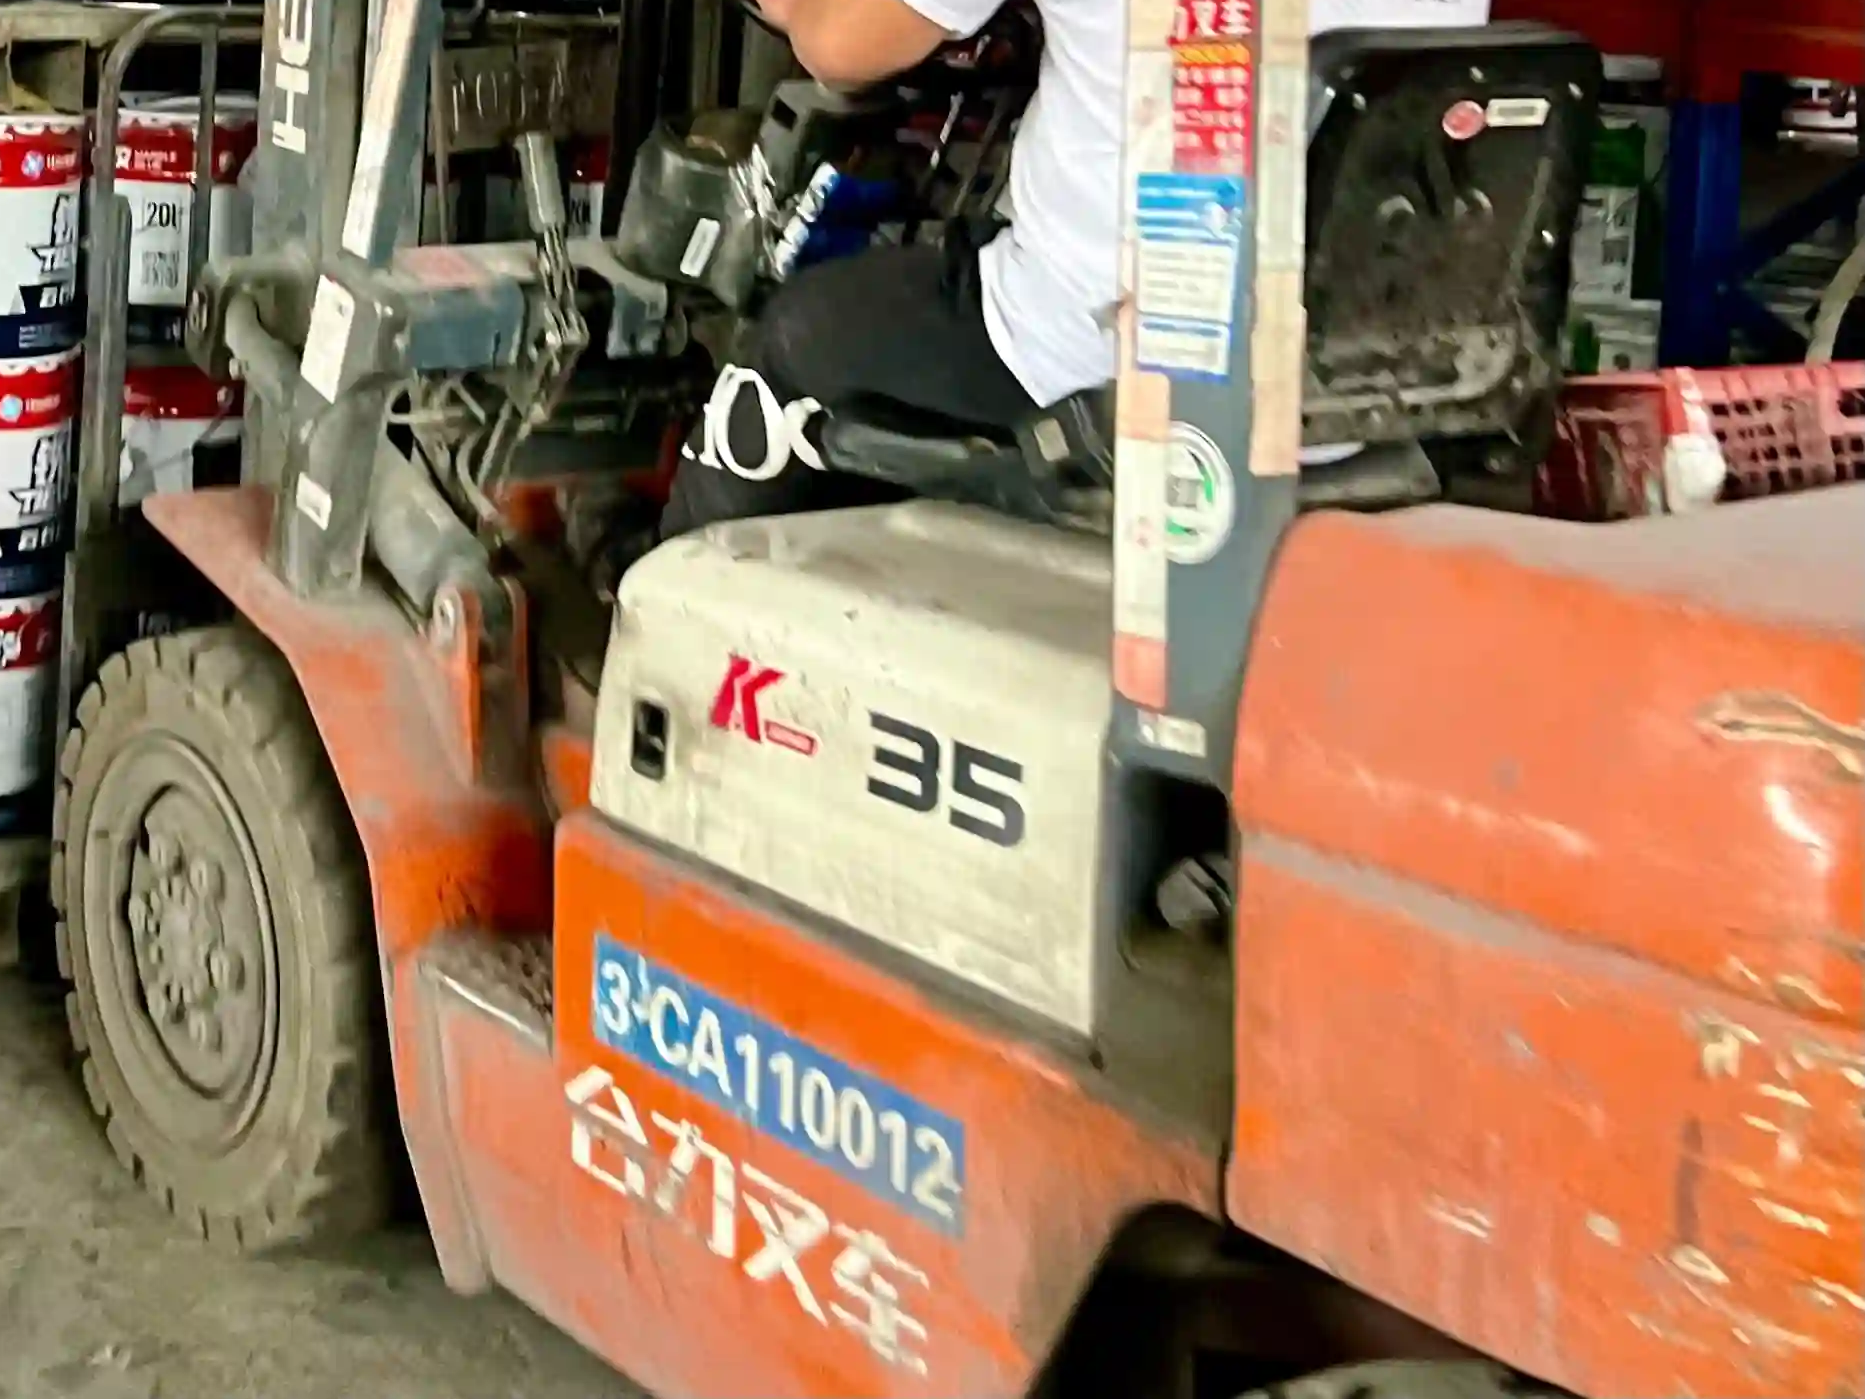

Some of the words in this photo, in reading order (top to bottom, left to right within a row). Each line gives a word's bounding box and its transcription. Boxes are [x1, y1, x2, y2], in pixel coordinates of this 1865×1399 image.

[710, 654, 787, 743] K
[867, 710, 1024, 848] 35
[565, 1065, 930, 1376] 合力叉车
